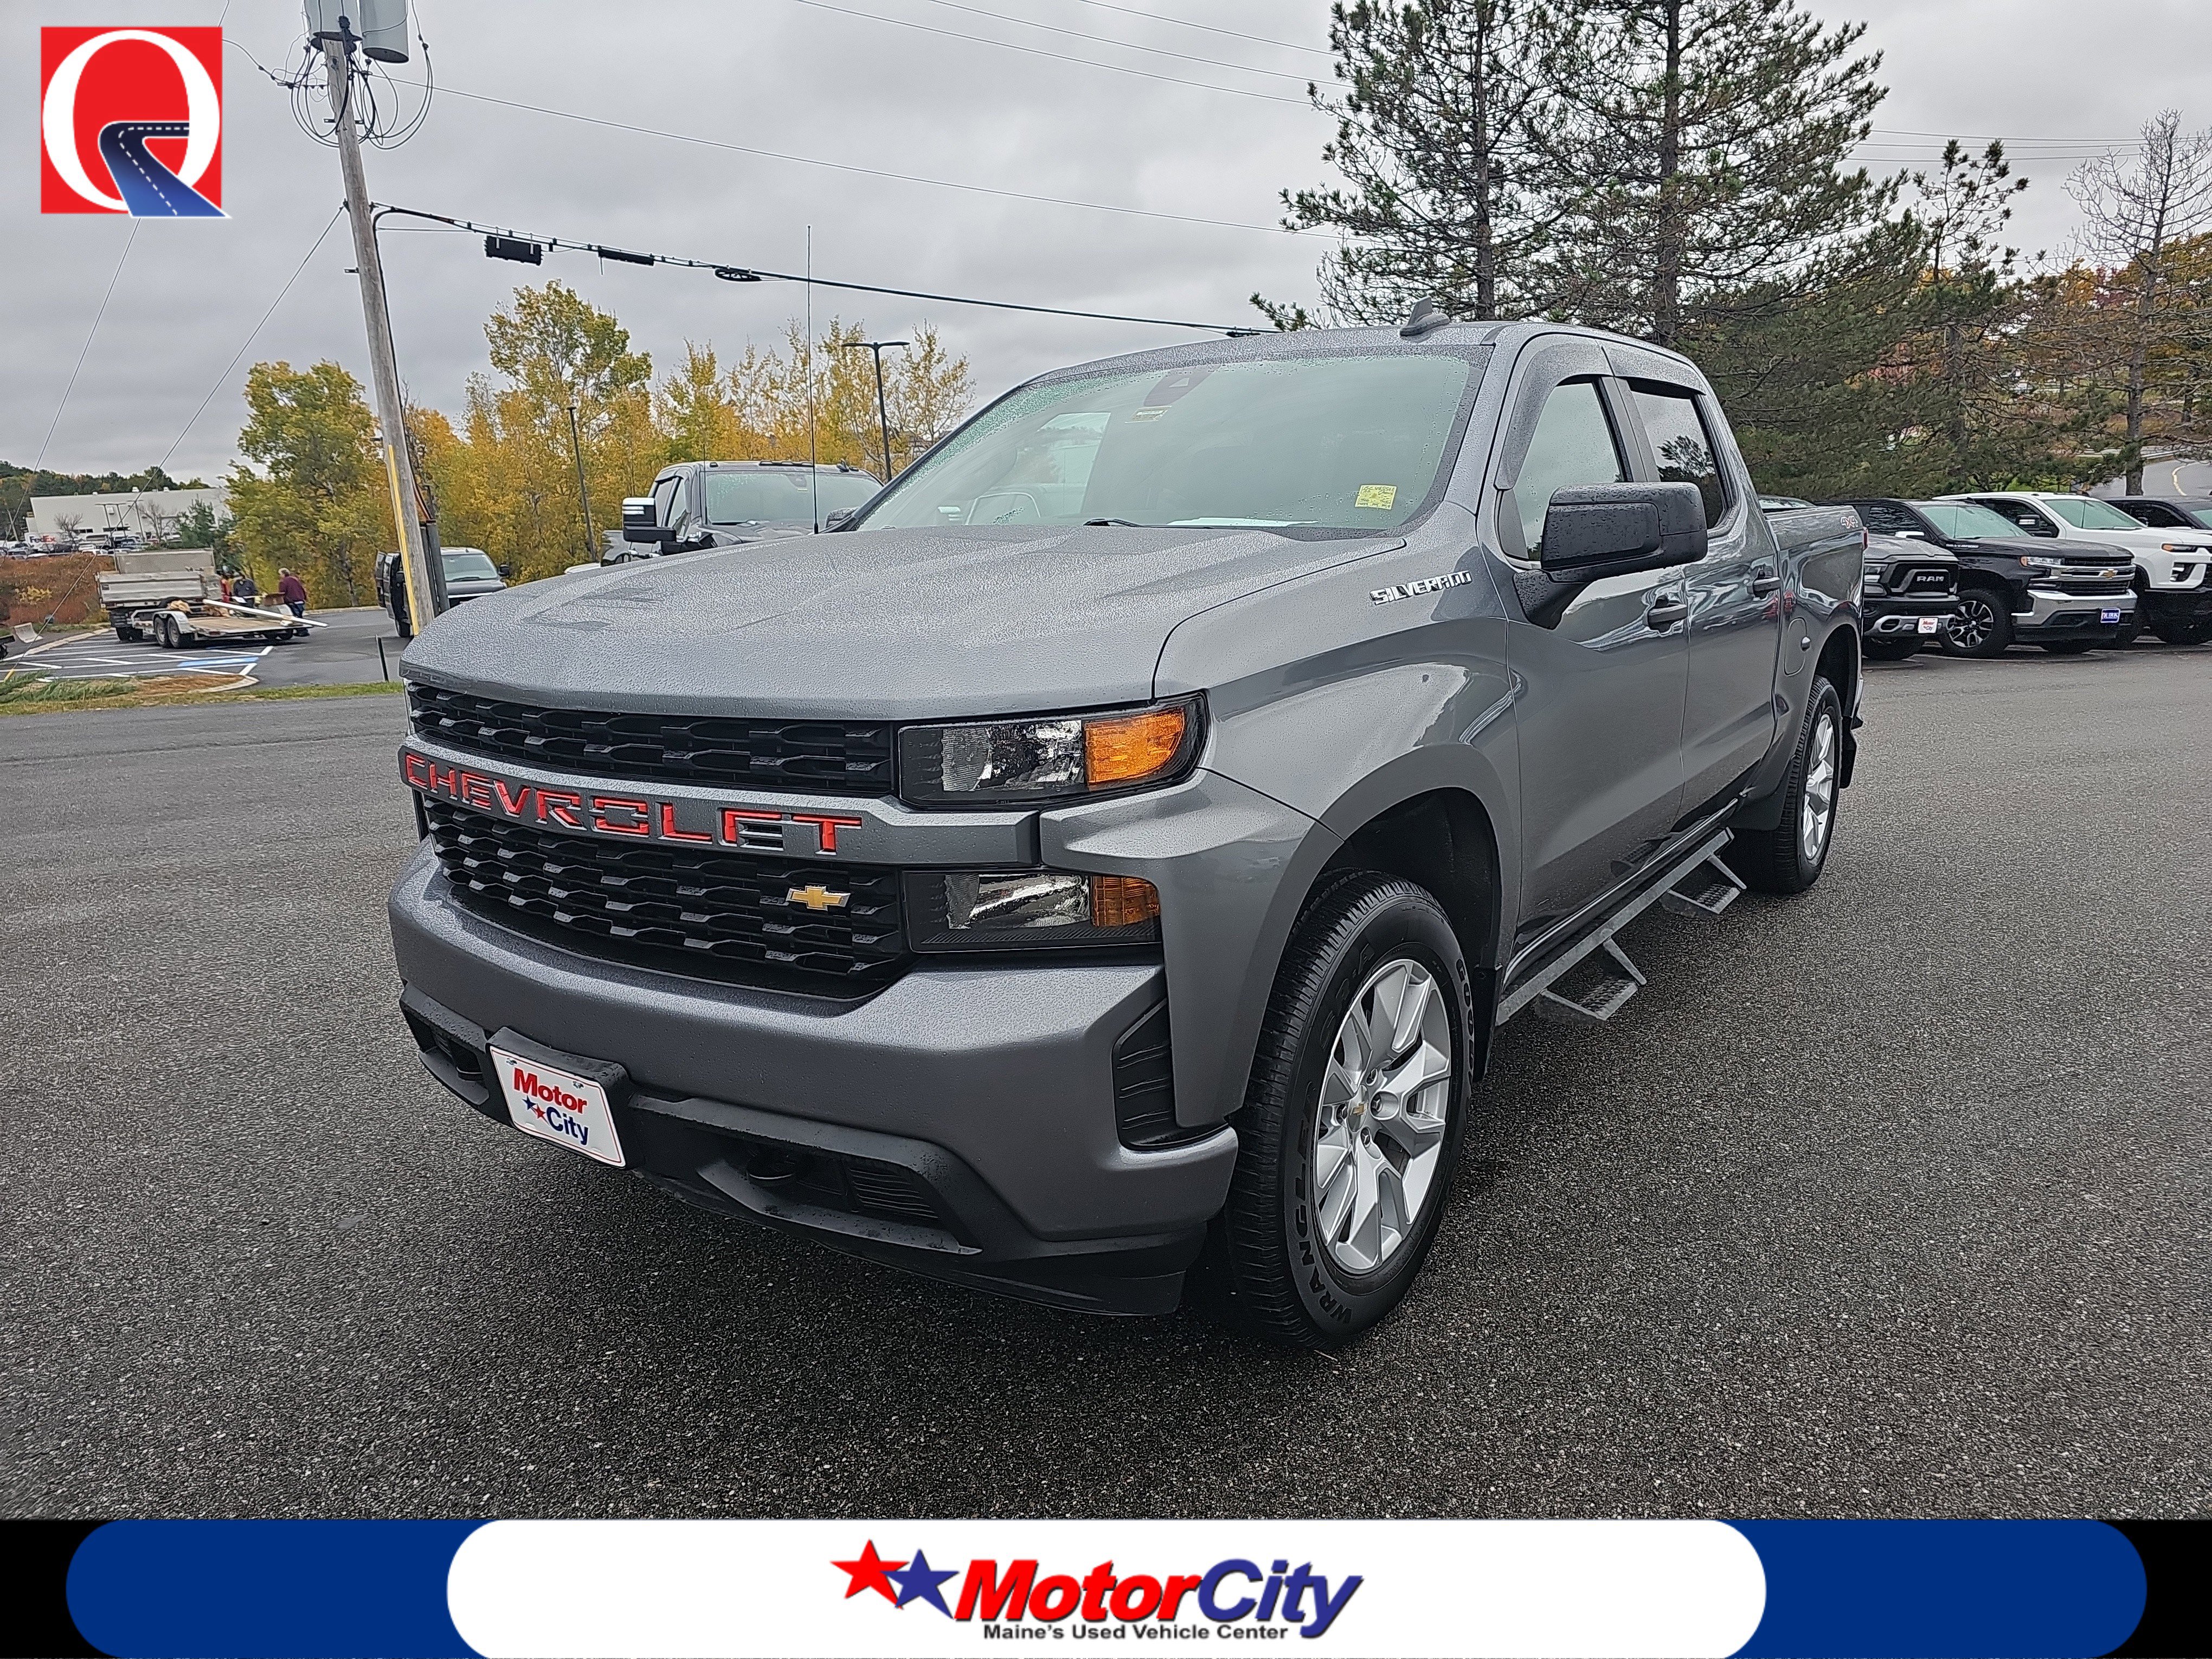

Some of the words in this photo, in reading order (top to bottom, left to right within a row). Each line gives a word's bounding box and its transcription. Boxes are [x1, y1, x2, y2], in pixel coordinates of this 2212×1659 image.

[1370, 571, 1472, 605] SILVERADO
[405, 754, 863, 856] CHEVROLET
[513, 1068, 588, 1114] Motor
[546, 1107, 588, 1145] City
